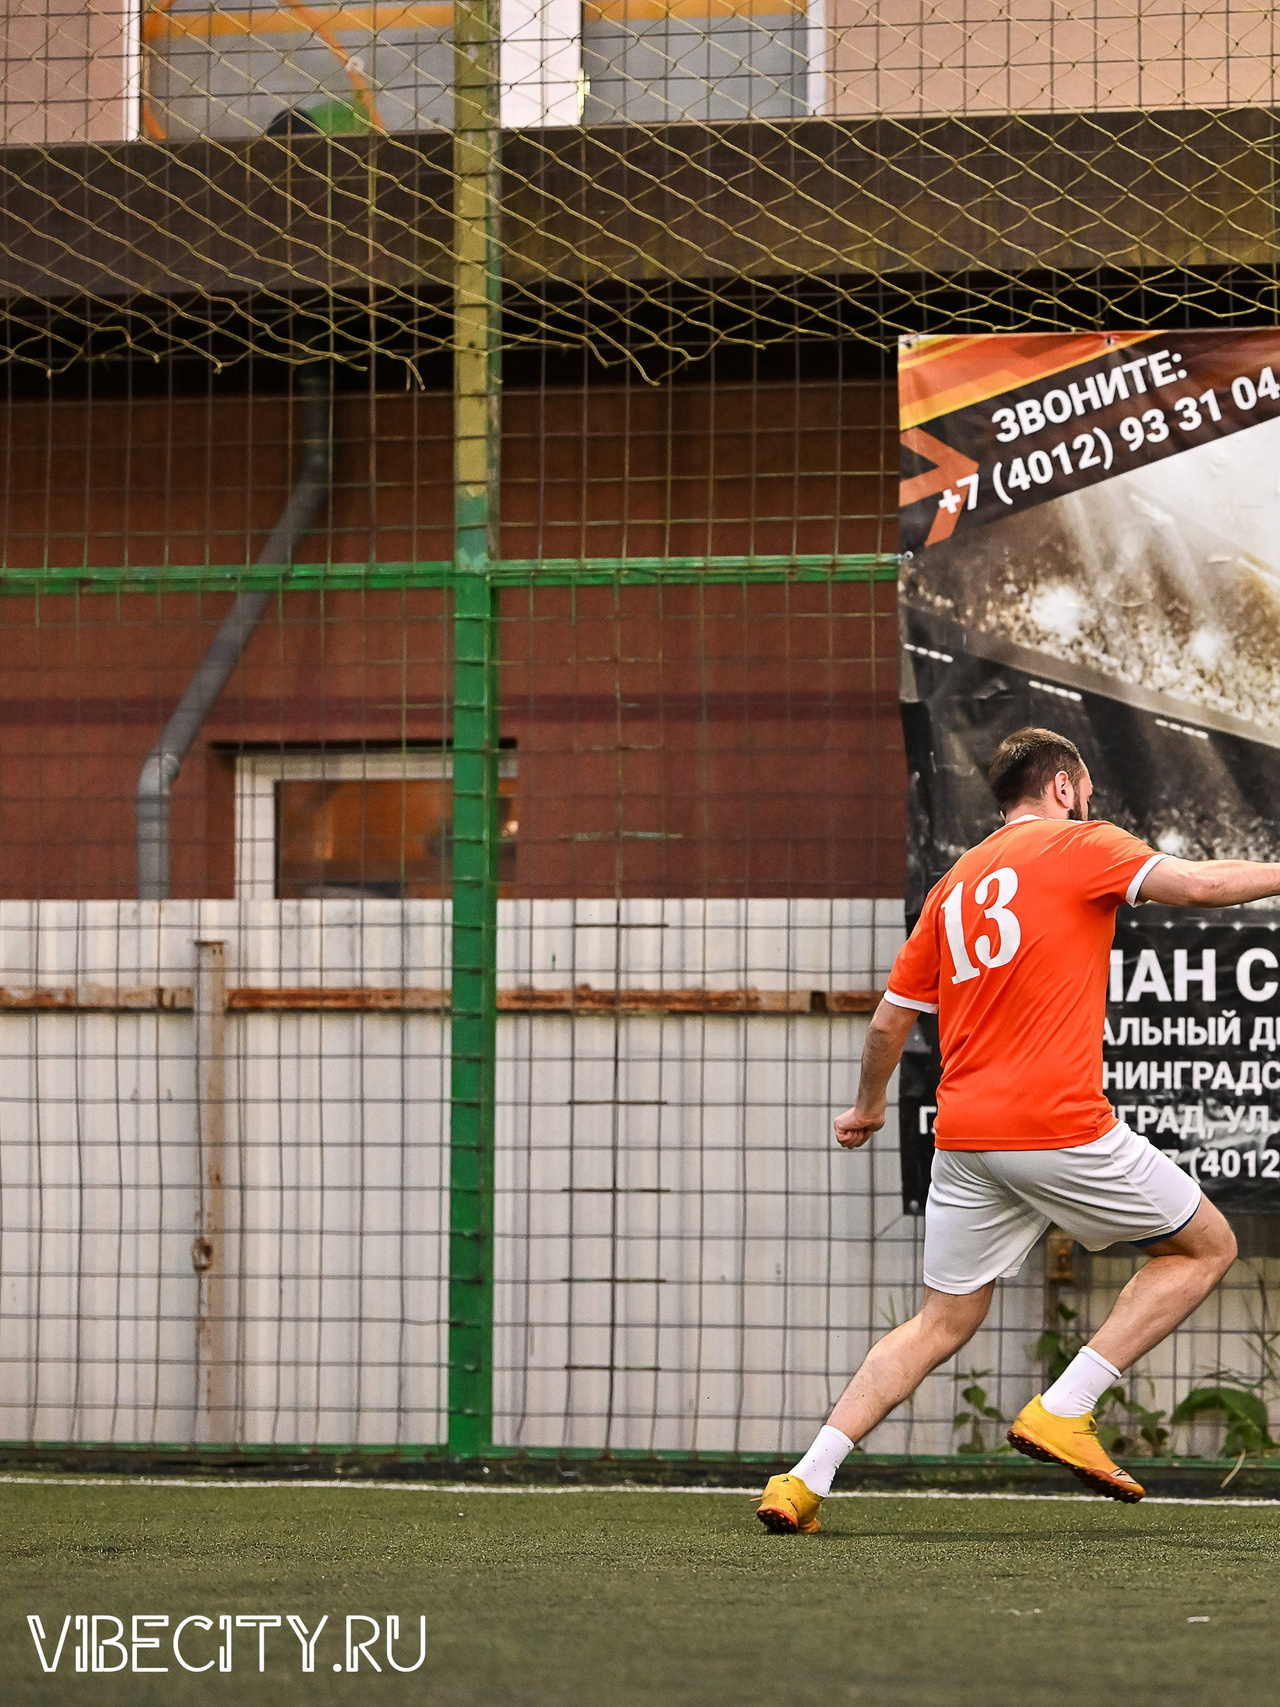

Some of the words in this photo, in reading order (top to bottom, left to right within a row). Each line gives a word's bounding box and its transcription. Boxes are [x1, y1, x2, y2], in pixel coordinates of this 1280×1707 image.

[938, 474, 980, 514] +7
[992, 427, 1114, 506] (4012)
[1120, 407, 1168, 453] 93
[1174, 389, 1223, 432] 31
[1232, 366, 1280, 412] 04
[991, 350, 1188, 443] ЗВОНИТЕ:
[941, 866, 1021, 985] 13
[1112, 1105, 1215, 1140] ГРАД,
